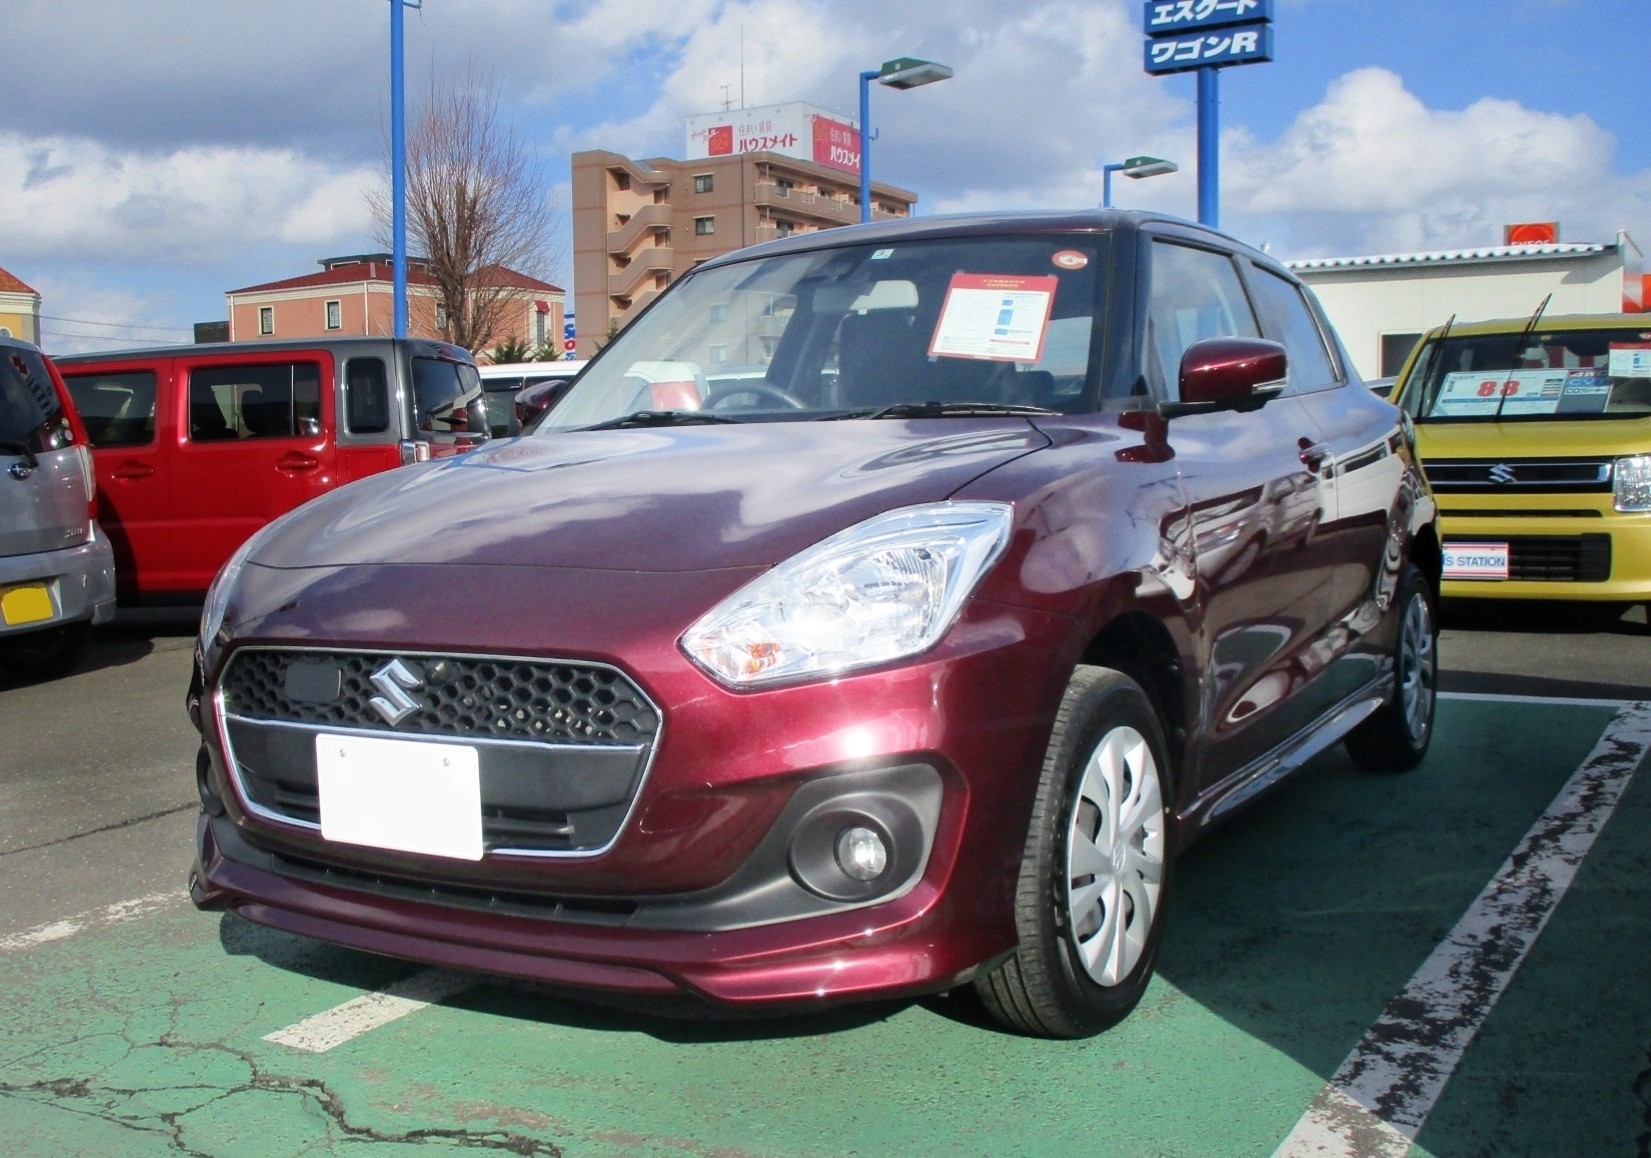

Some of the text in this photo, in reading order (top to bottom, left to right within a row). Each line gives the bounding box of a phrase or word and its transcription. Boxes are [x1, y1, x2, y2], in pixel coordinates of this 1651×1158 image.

[1151, 31, 1258, 63] ワゴンR
[738, 133, 798, 152] ハウスメイト
[829, 144, 861, 169] ハウスメイ
[1457, 556, 1505, 567] STATION
